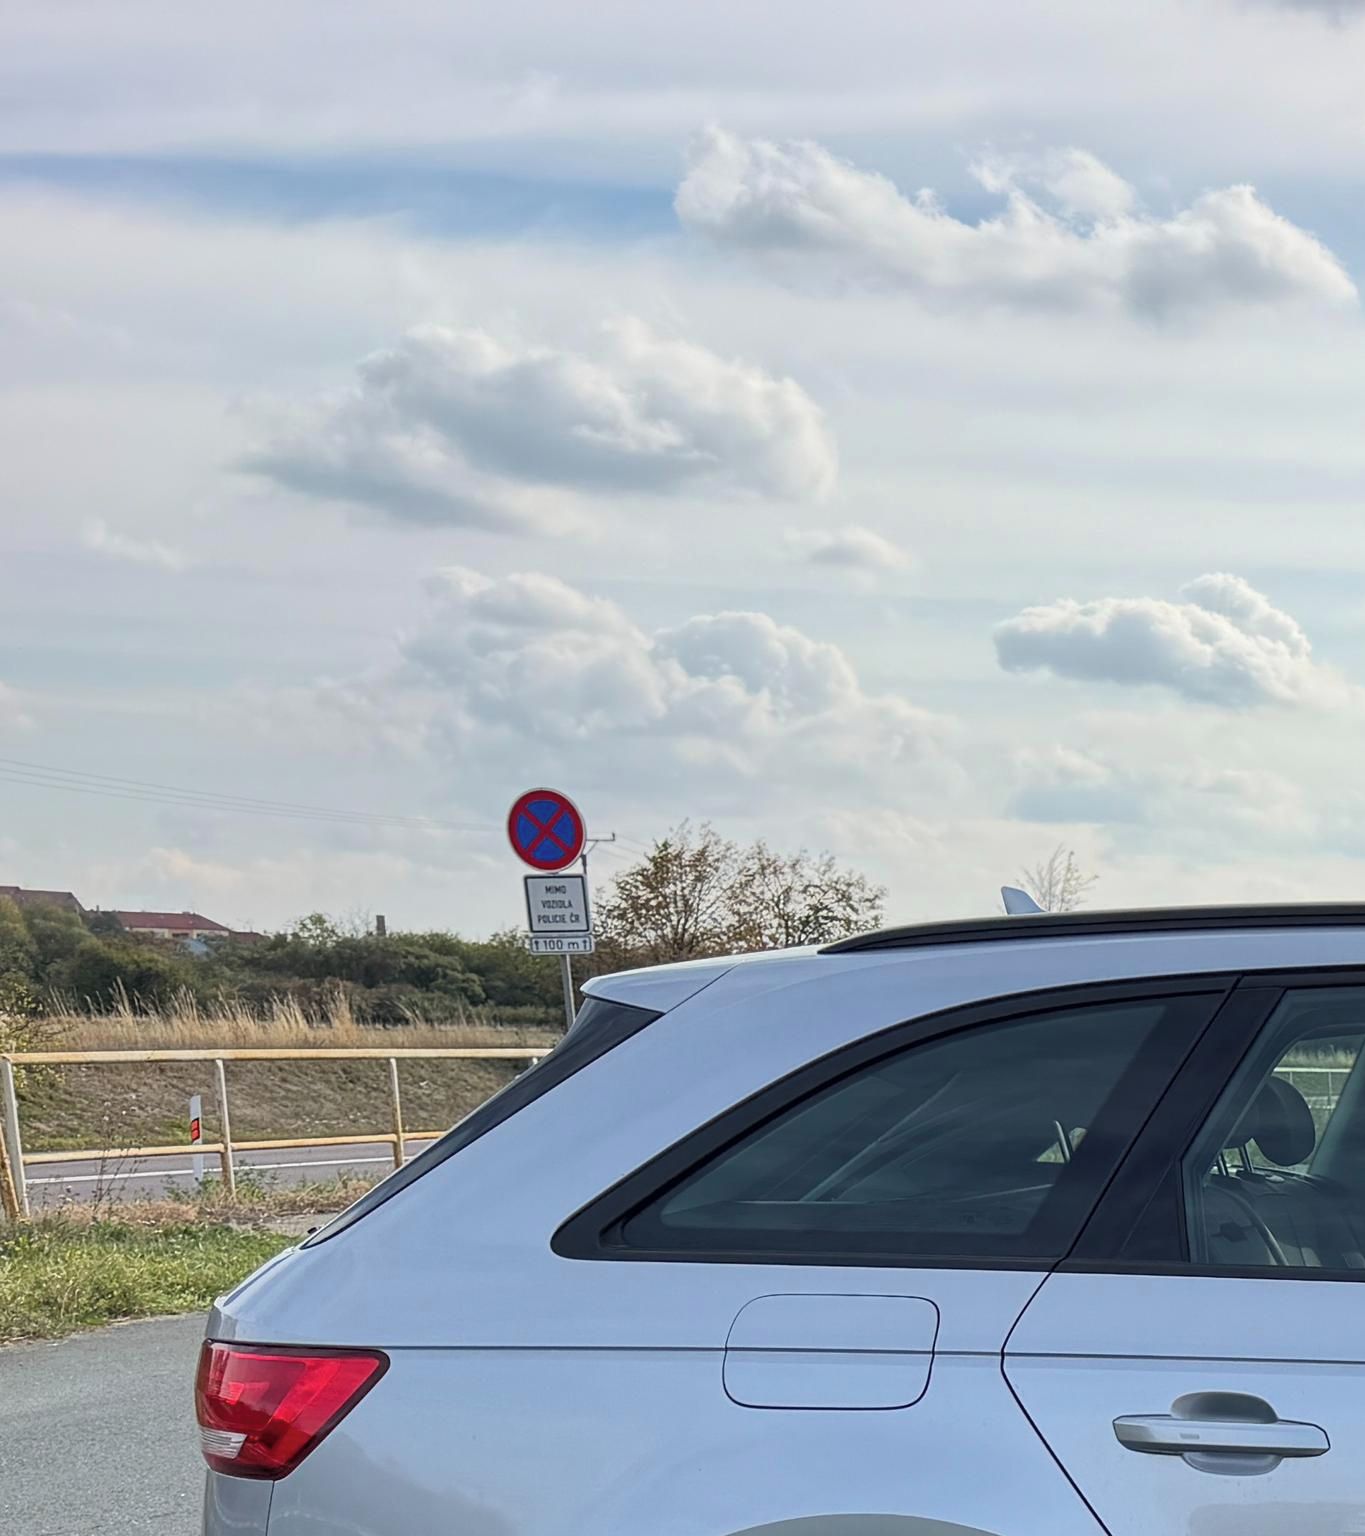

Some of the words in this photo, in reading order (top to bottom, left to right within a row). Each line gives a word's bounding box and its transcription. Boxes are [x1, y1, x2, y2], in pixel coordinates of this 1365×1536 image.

[545, 885, 566, 894] MIMO
[541, 900, 573, 909] VOZIDLA
[537, 914, 566, 923] POLICIE
[570, 912, 579, 923] ČR
[543, 939, 563, 950] 100
